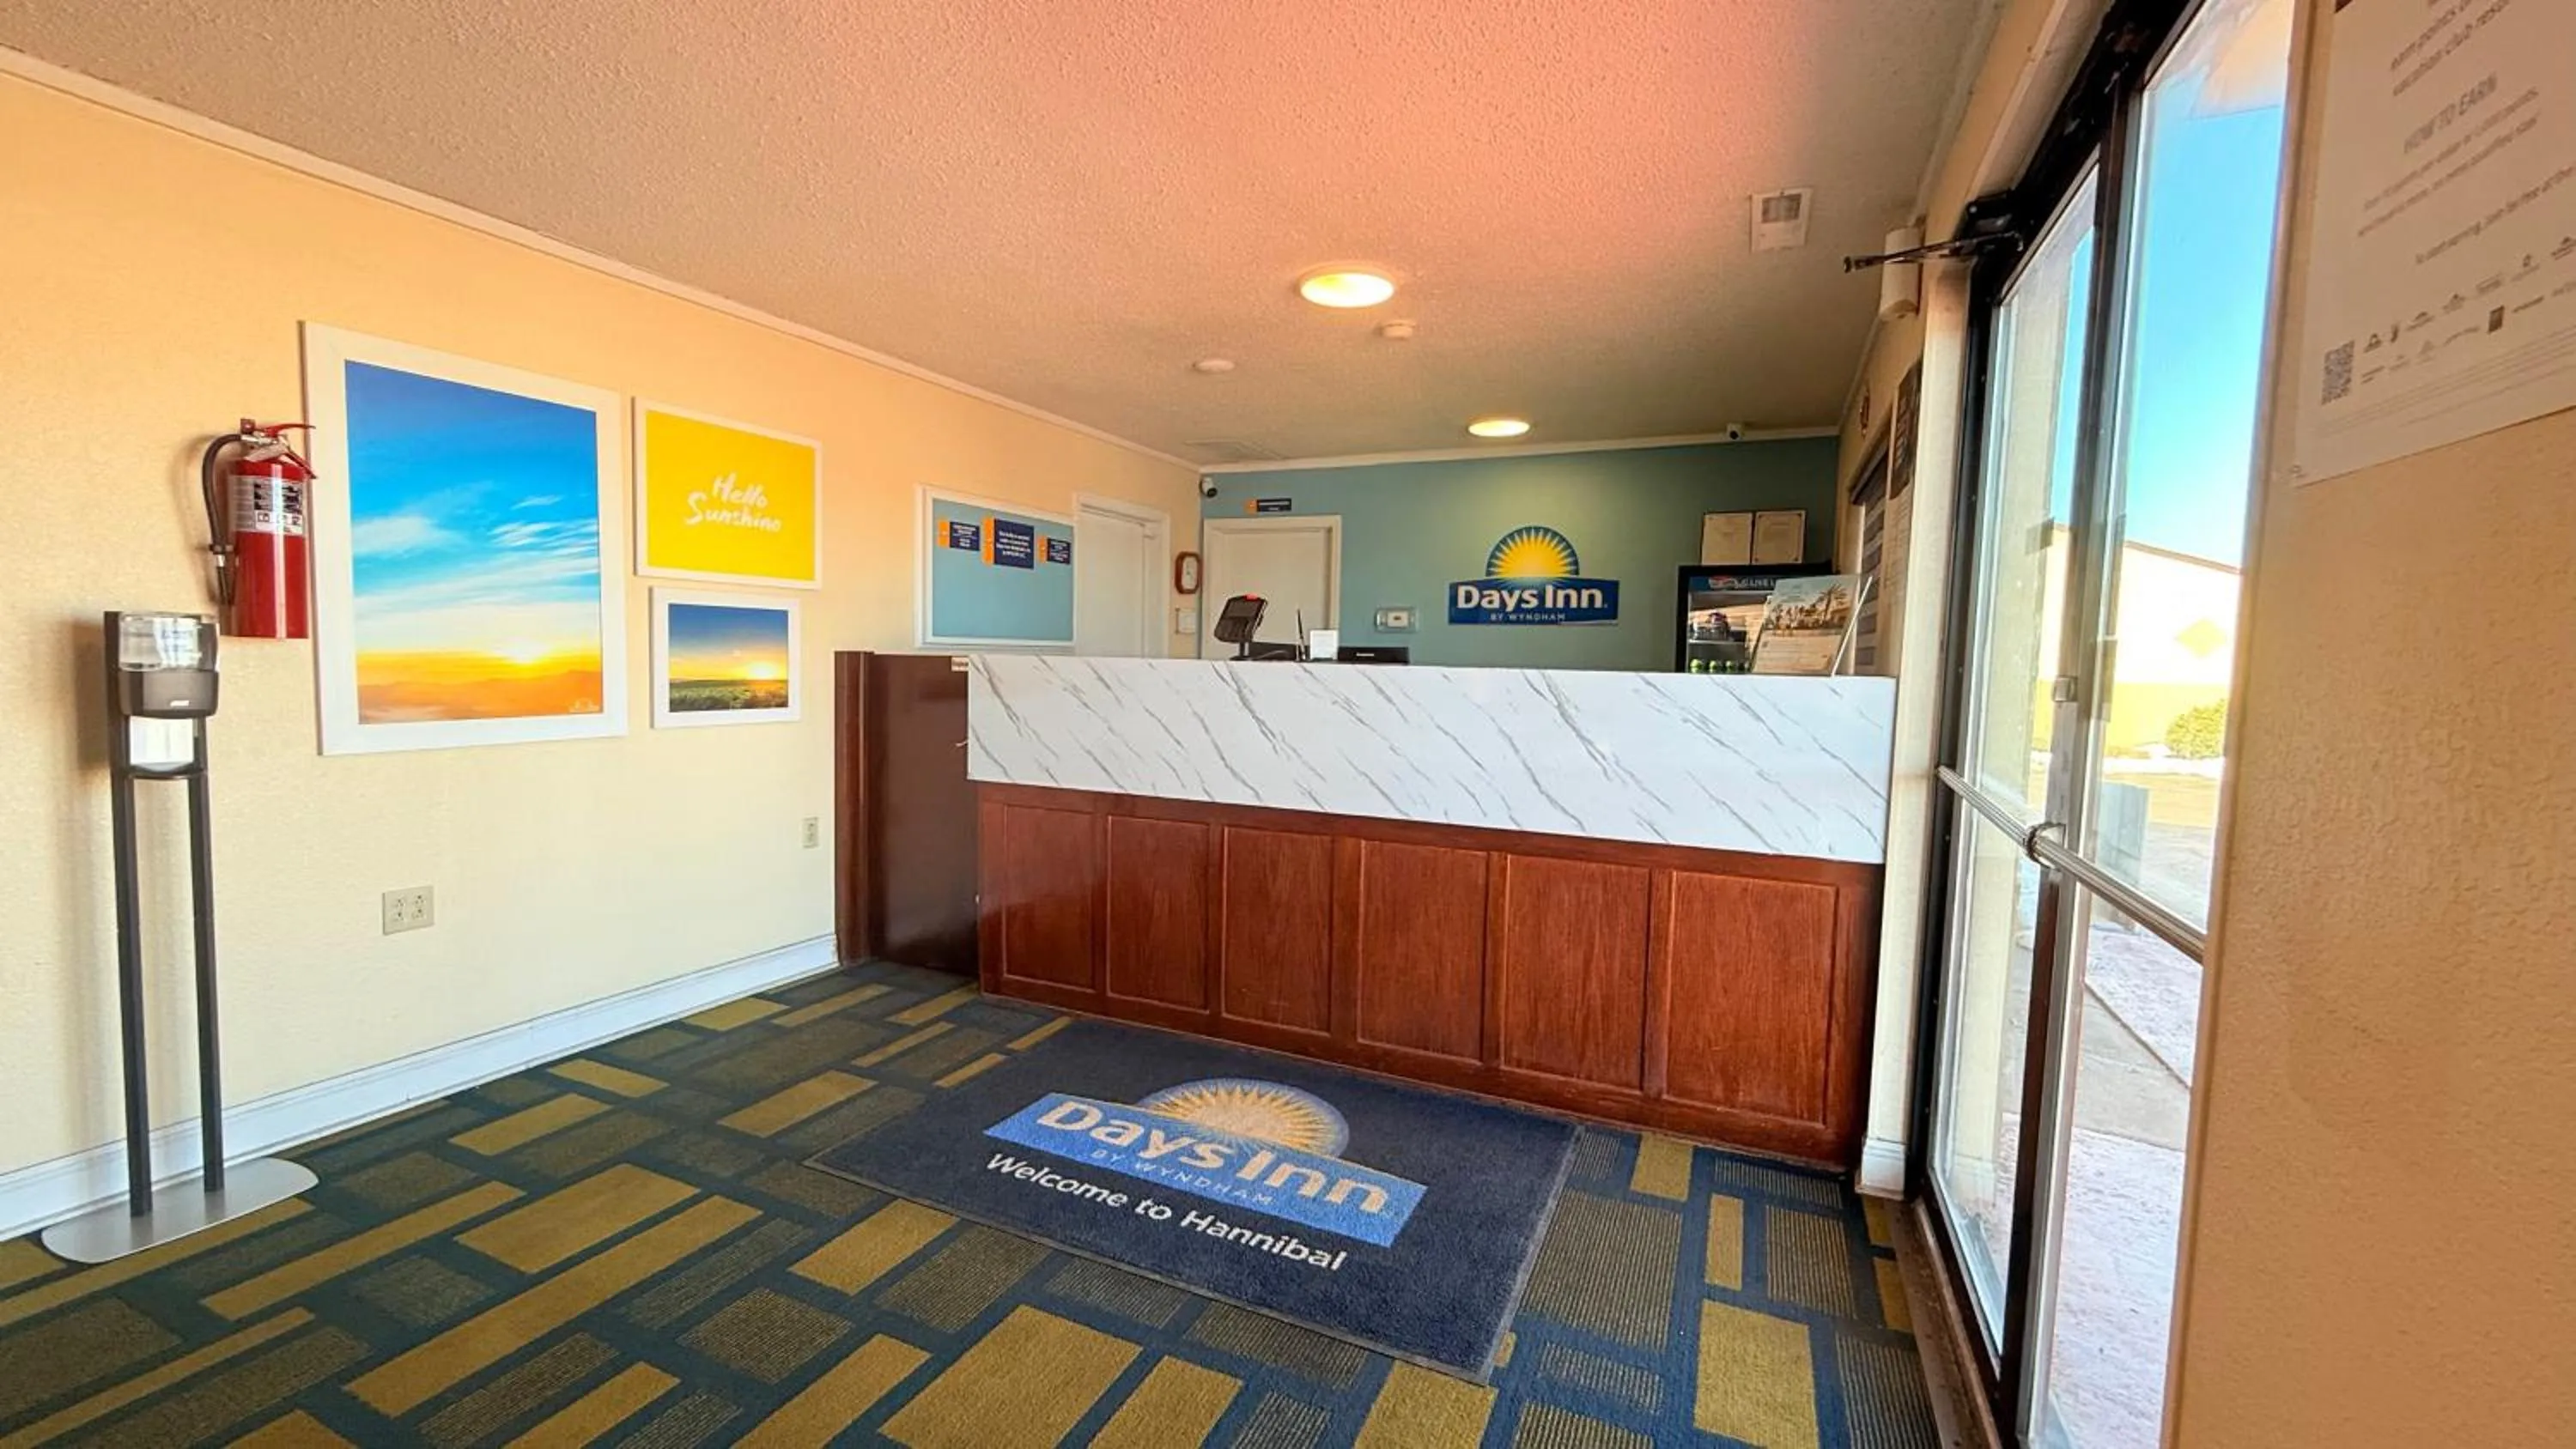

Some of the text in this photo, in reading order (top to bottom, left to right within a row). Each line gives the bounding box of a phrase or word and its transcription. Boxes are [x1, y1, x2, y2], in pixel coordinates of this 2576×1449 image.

[712, 472, 768, 508] Hello
[685, 492, 781, 532] Sunshine
[1456, 585, 1604, 612] Days Inn
[1509, 612, 1566, 621] WYNDHAM
[1036, 1100, 1390, 1215] Days Inn
[1091, 1148, 1277, 1206] BY WYNDHAM
[986, 1152, 1348, 1272] Welcome to Hannibal
